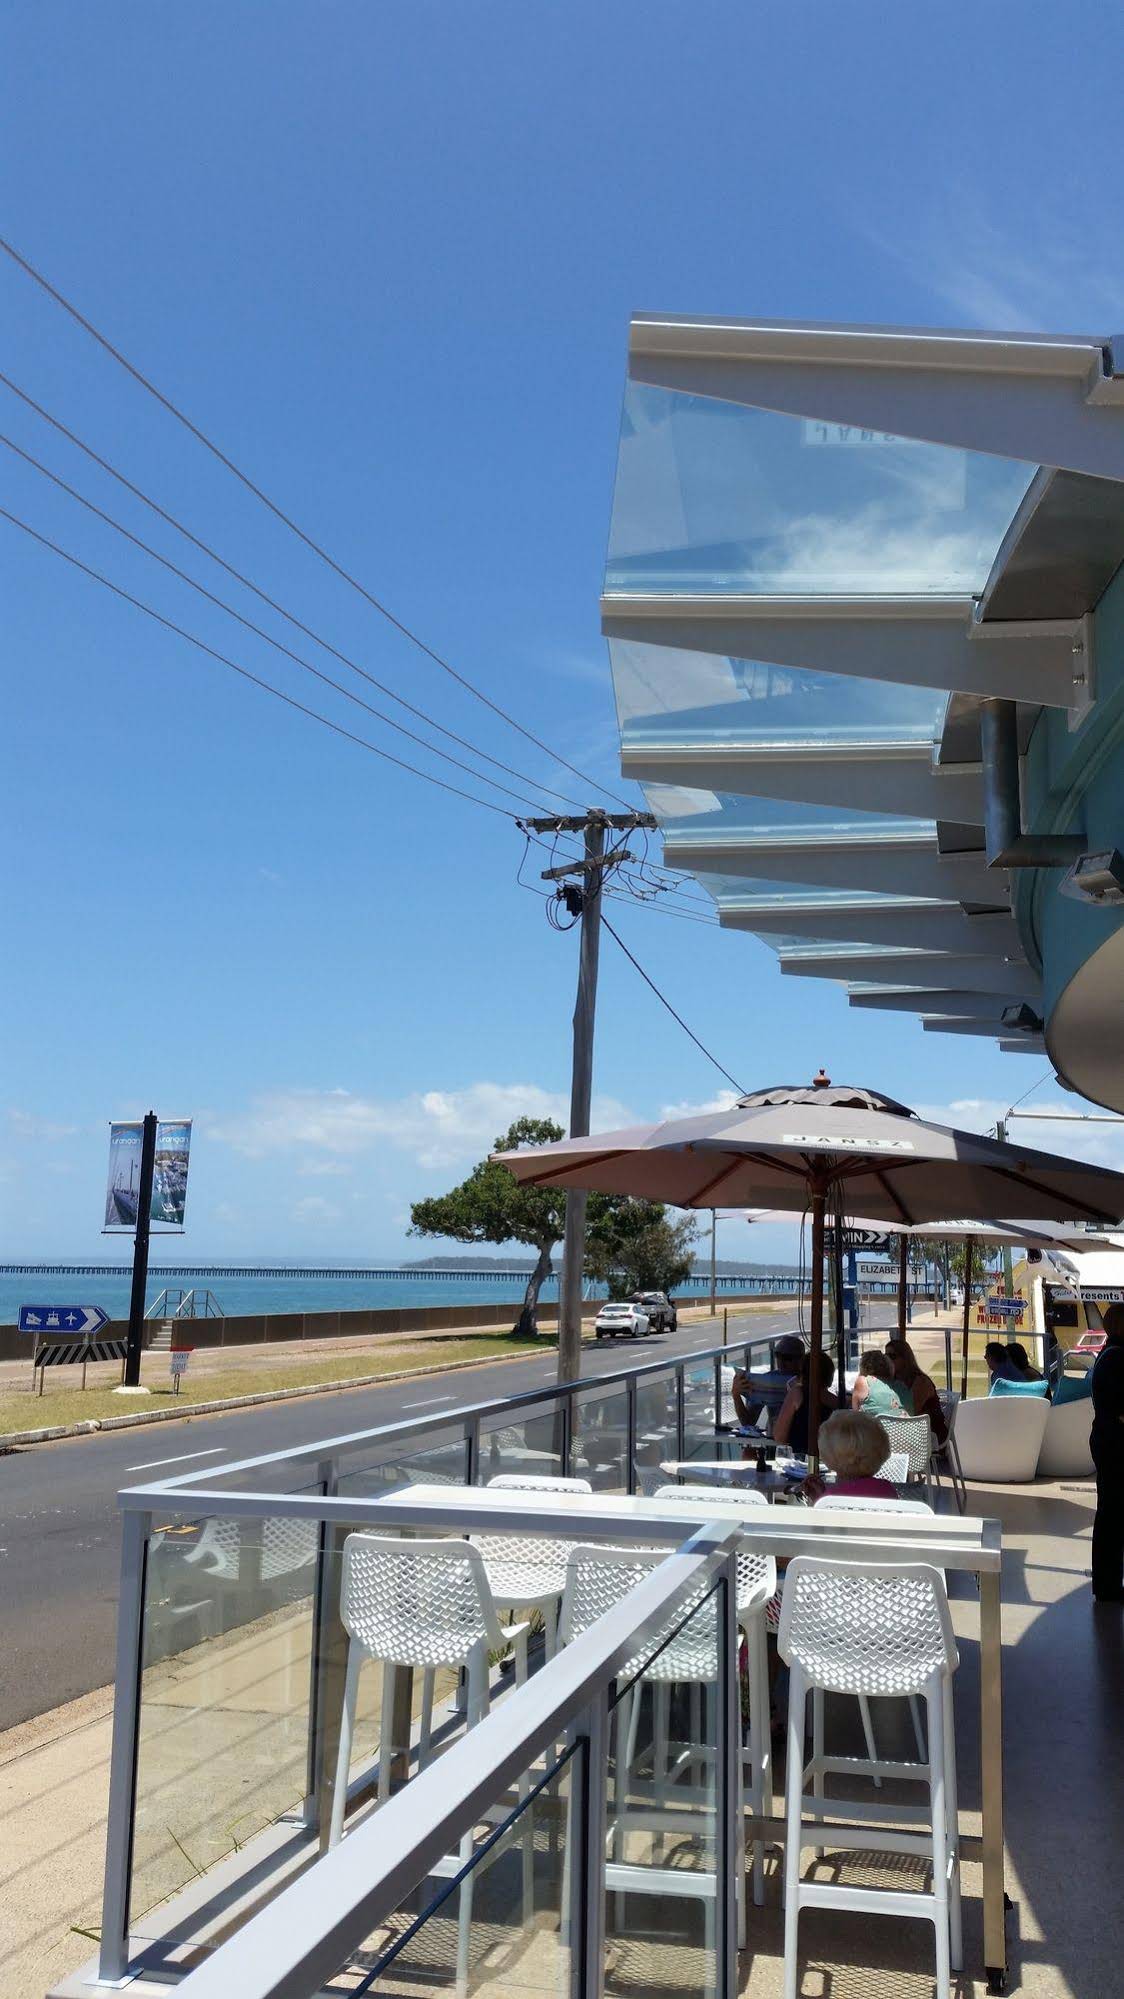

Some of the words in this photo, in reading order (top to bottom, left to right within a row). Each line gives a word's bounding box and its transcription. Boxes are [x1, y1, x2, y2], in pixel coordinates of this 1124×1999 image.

[793, 1136, 903, 1148] JANSZ
[860, 1265, 901, 1275] ELIZABET
[911, 1266, 923, 1275] ST
